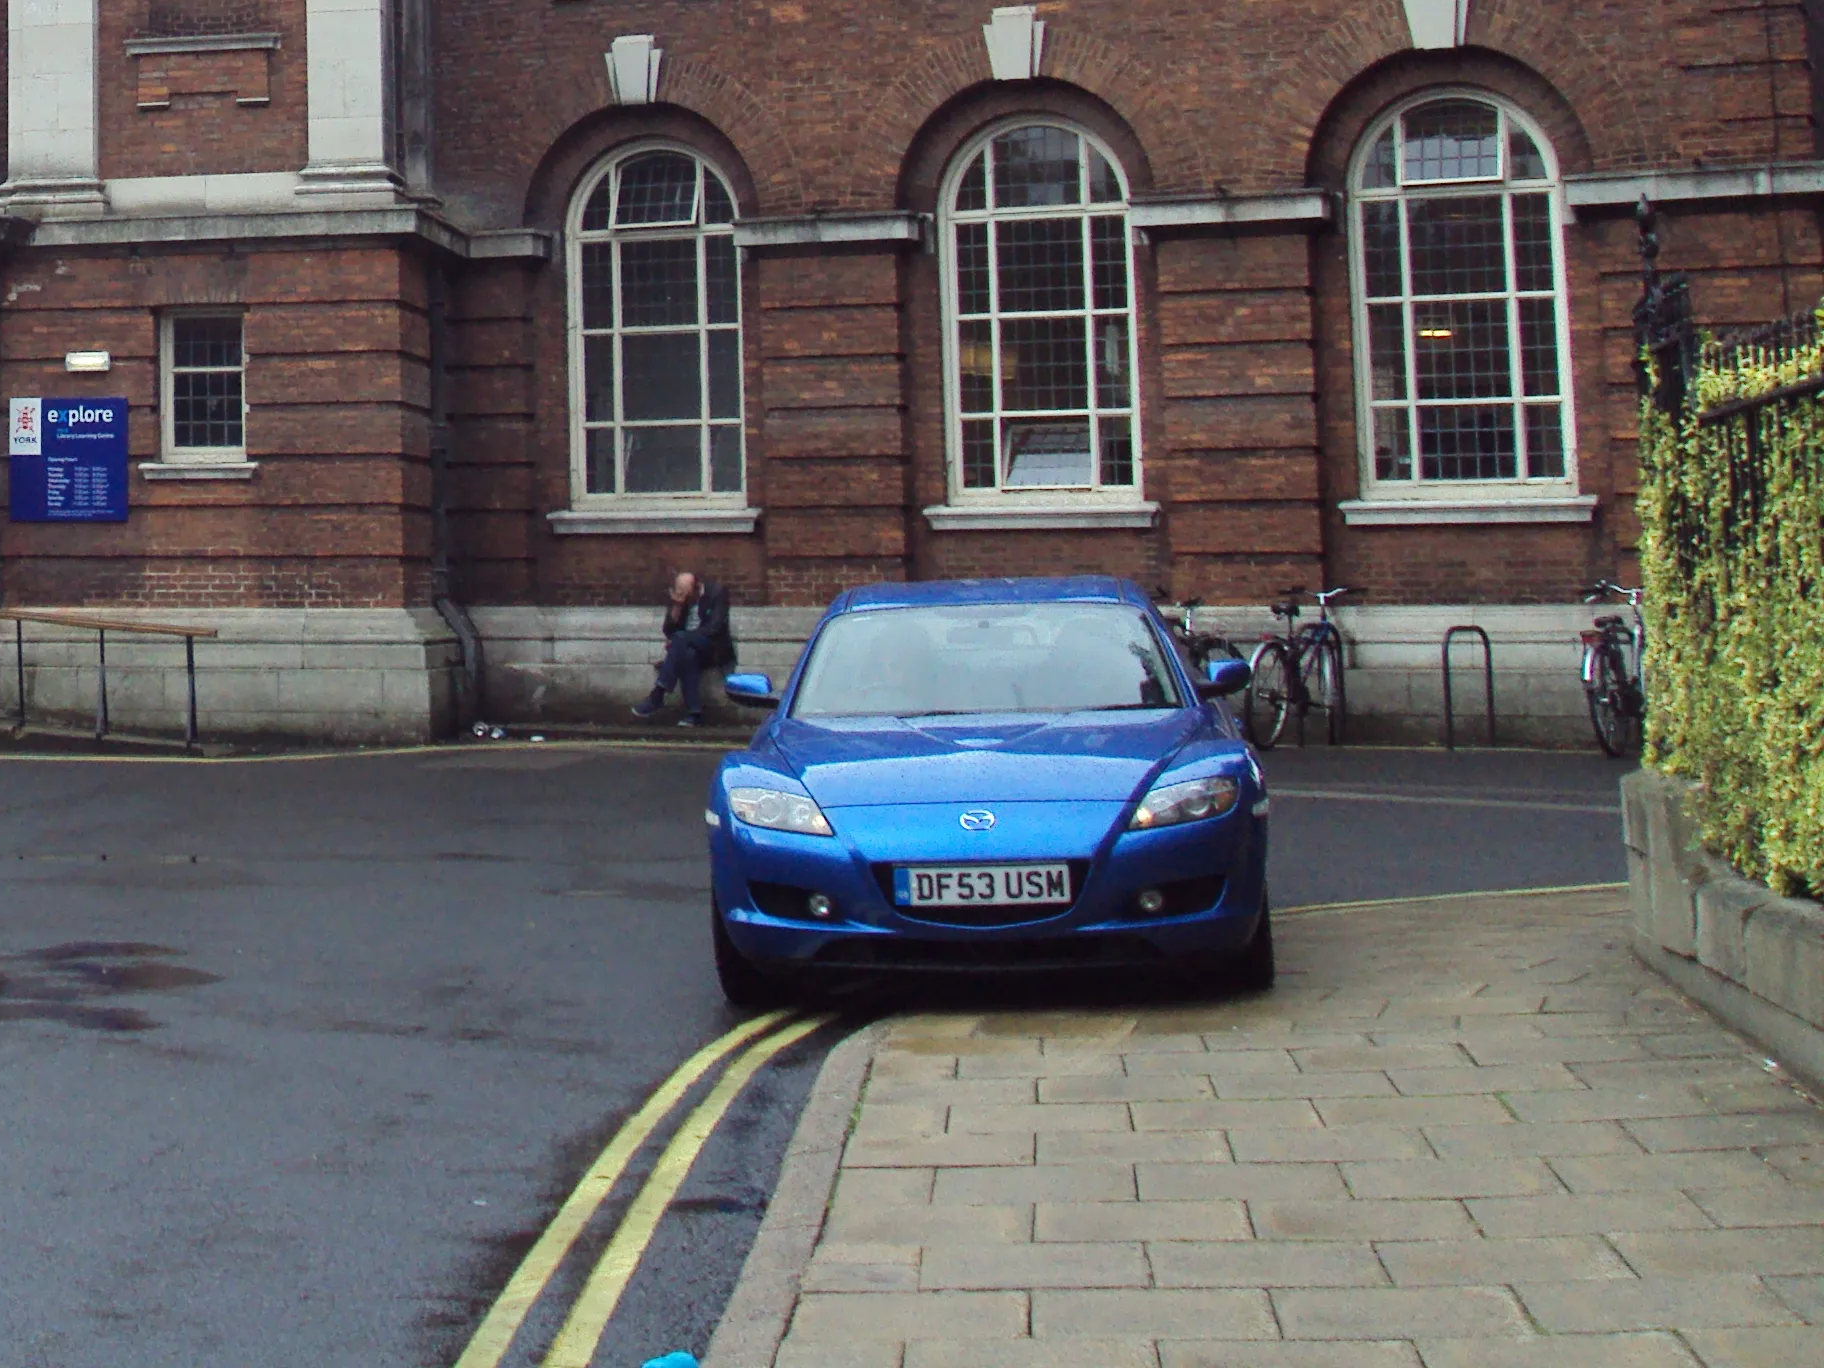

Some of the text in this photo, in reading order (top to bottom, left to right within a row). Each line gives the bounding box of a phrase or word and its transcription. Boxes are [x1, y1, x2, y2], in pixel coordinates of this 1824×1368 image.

[47, 405, 114, 427] explore
[13, 436, 37, 444] YORK
[915, 870, 1066, 901] DF53 USM
